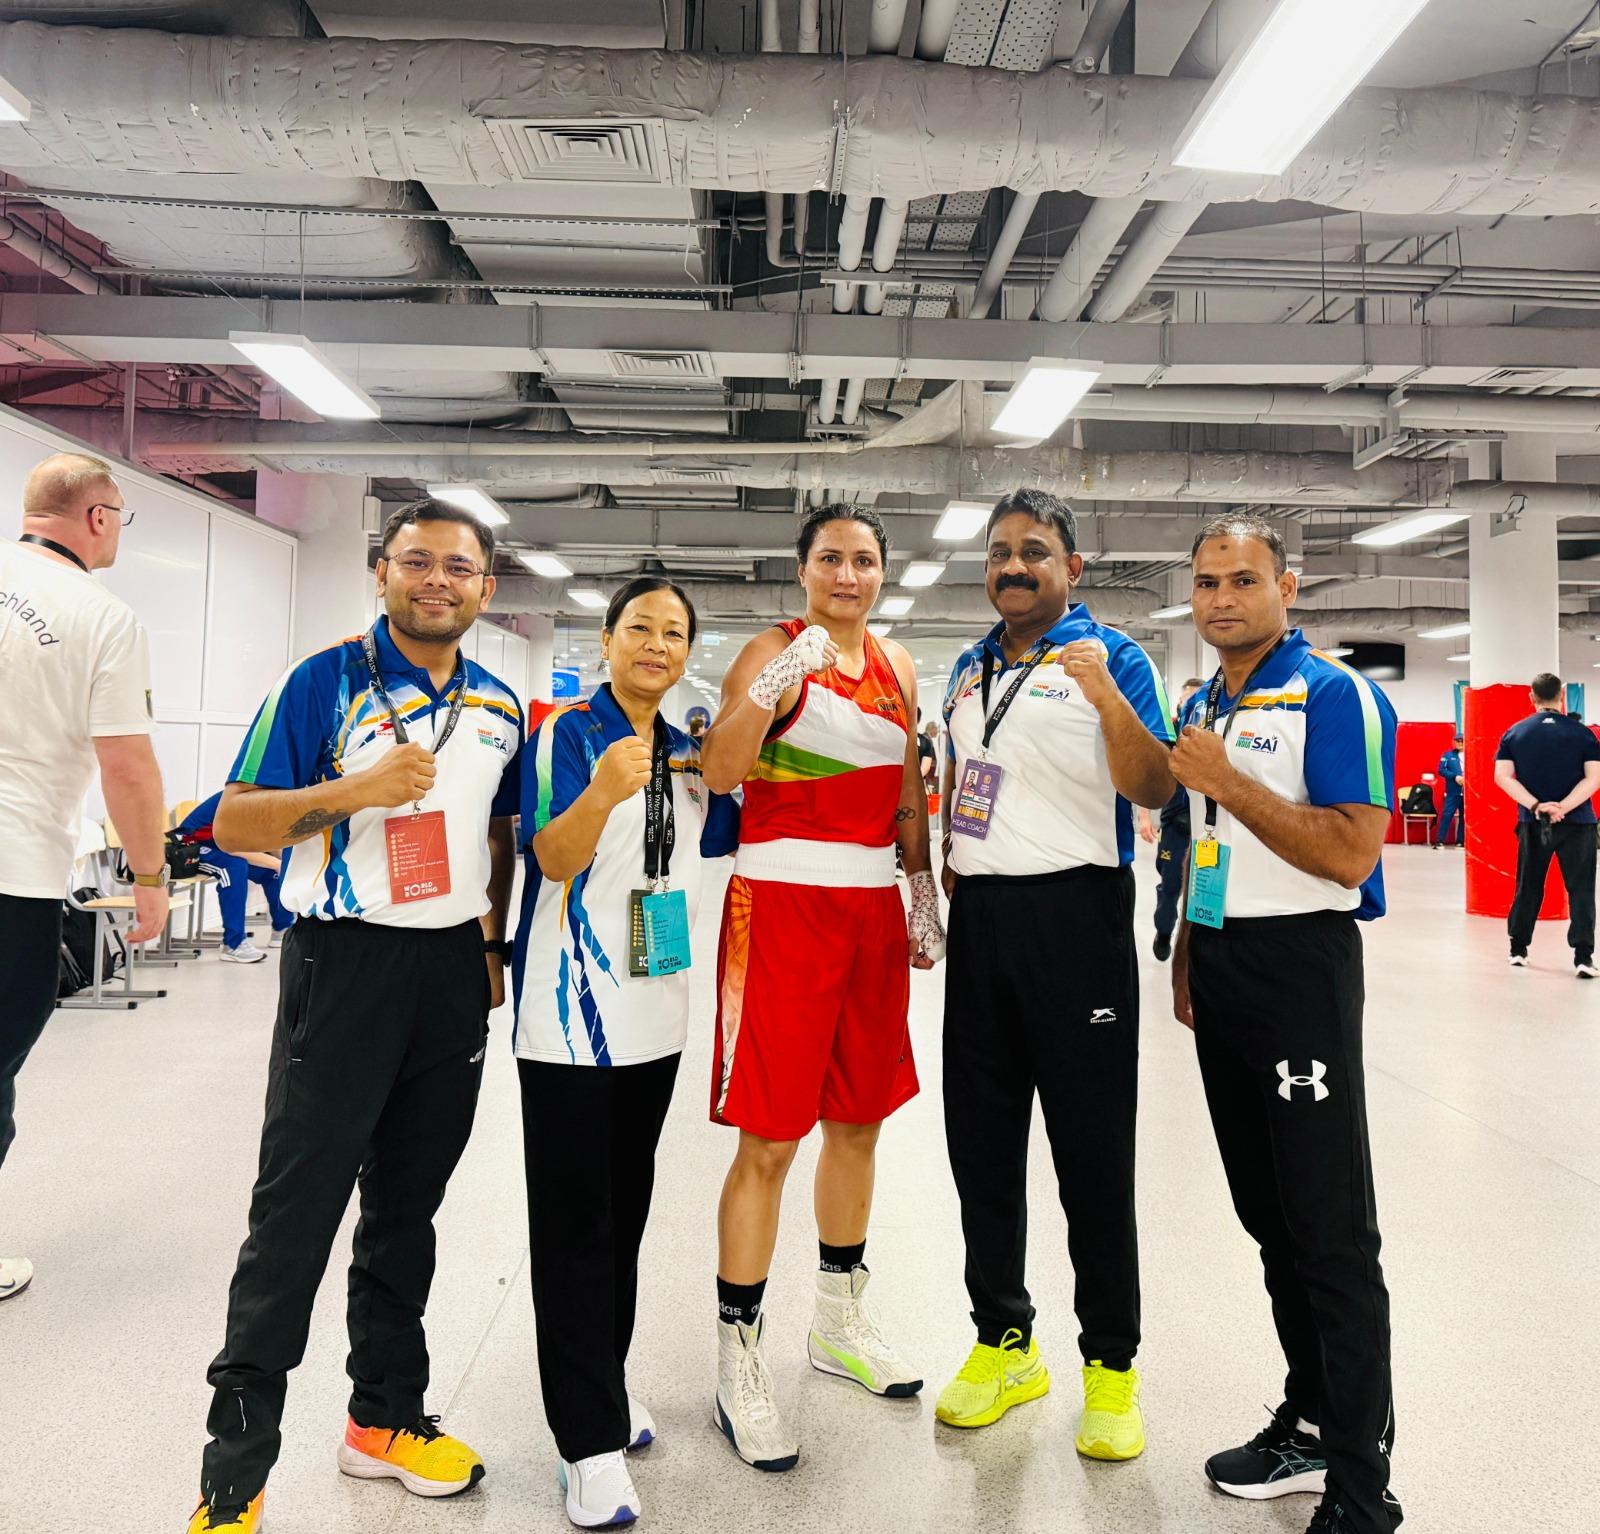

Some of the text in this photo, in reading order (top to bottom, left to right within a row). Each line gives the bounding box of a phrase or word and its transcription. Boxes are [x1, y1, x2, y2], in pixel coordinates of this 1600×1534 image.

[1003, 681, 1020, 704] ASTANA
[1252, 736, 1278, 752] SAI
[655, 777, 663, 792] 2025
[647, 794, 655, 821] ASTANA
[654, 794, 662, 821] ASTANA
[967, 822, 988, 833] COACH
